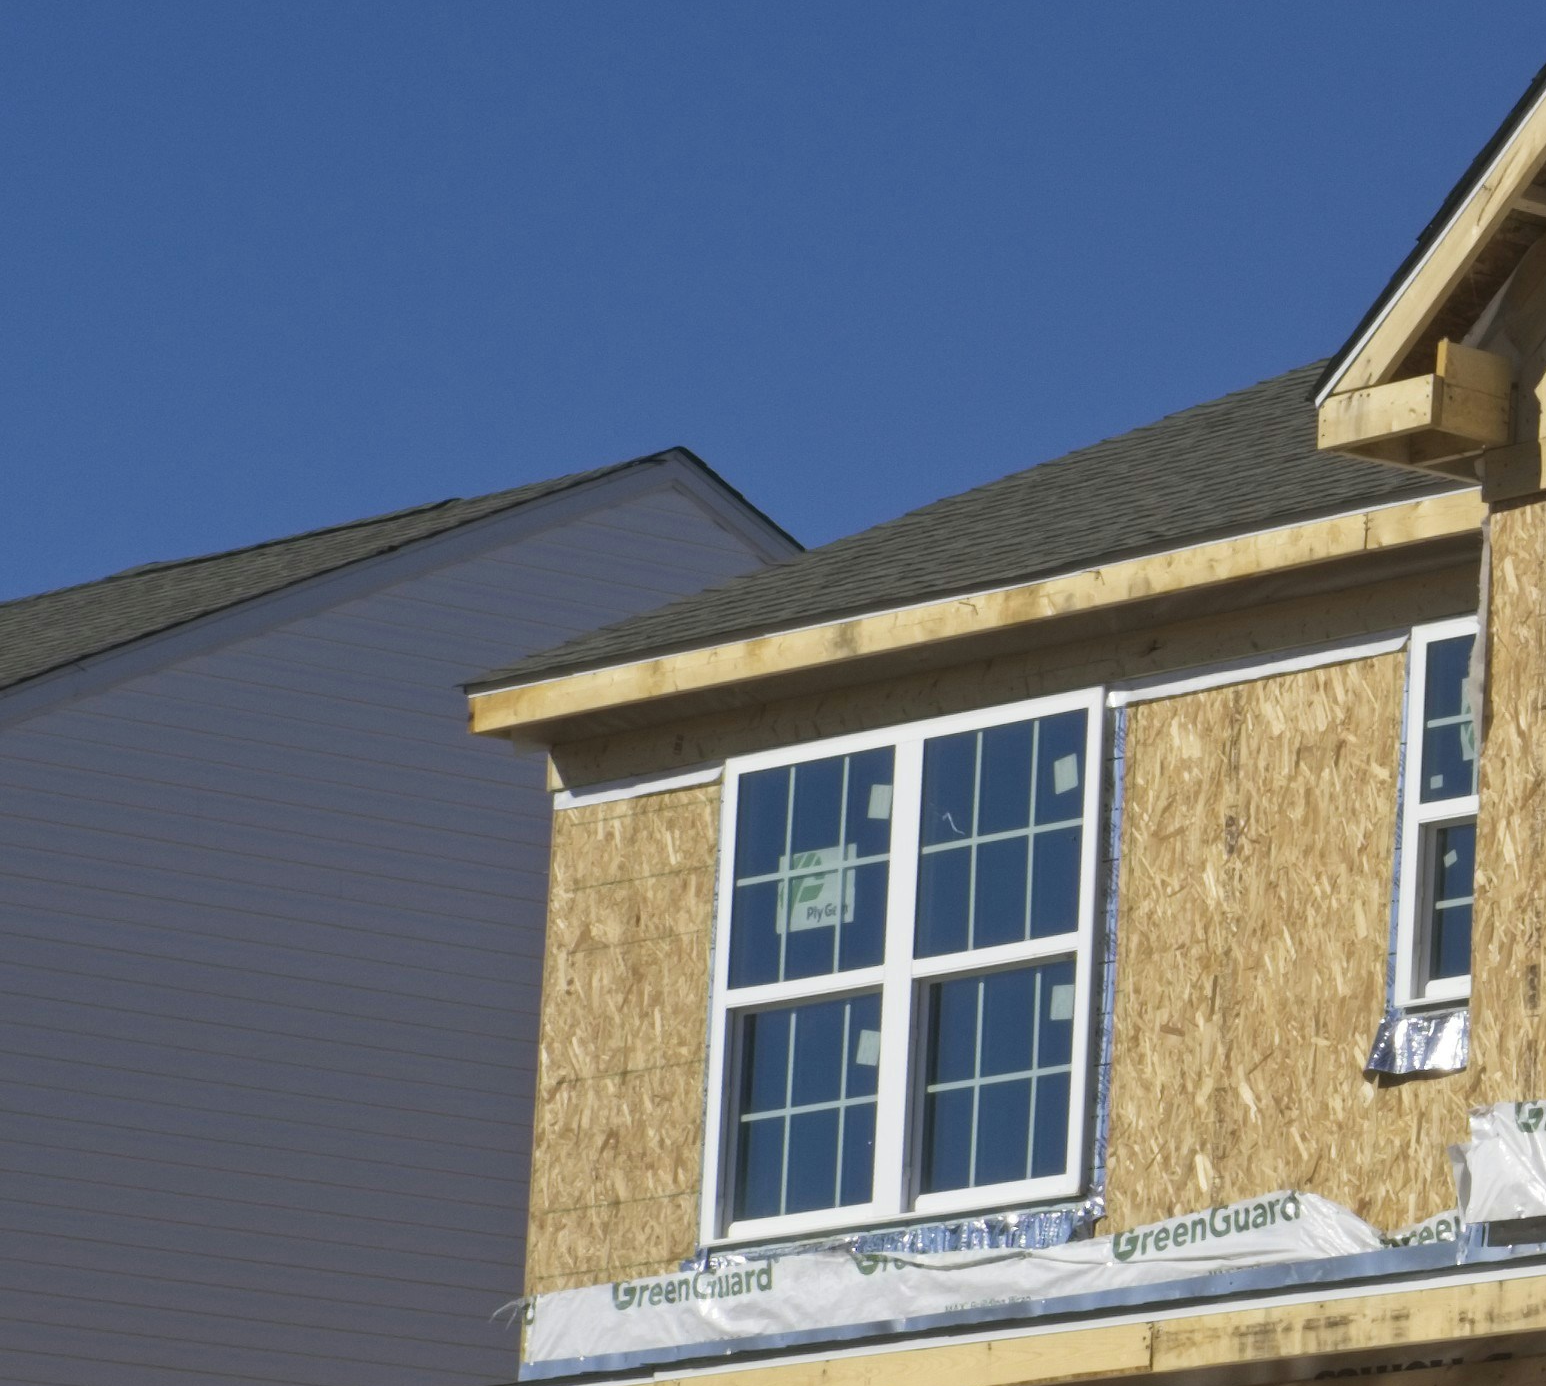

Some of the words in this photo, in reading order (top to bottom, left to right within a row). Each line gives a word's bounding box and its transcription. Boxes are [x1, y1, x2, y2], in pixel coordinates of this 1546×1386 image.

[807, 905, 823, 923] Ply
[1111, 1189, 1304, 1263] GreenGuard
[611, 1256, 776, 1312] GreenGuard
